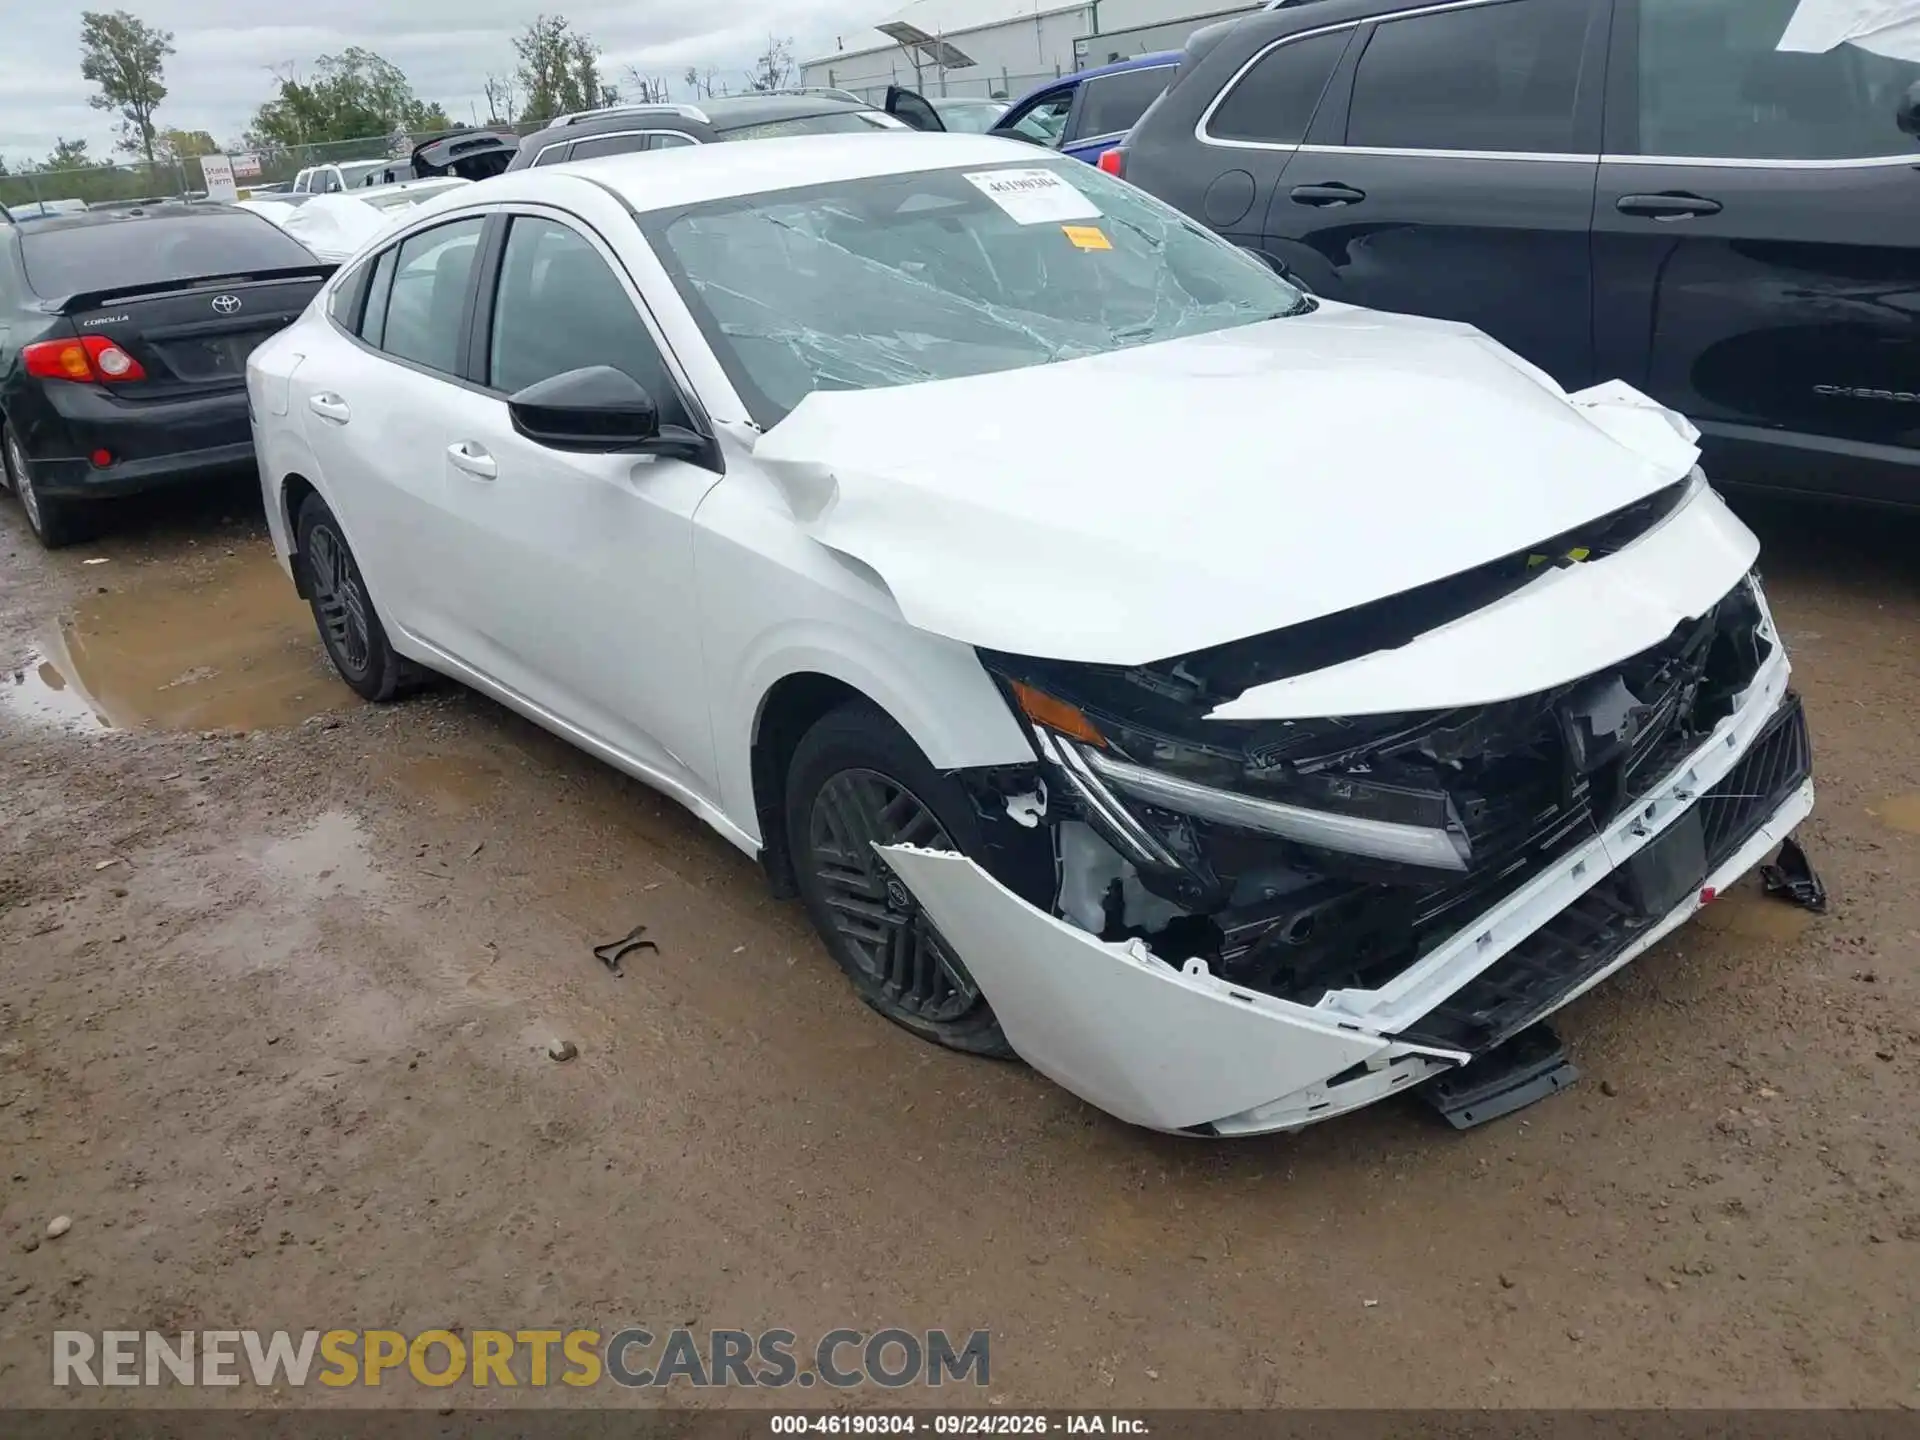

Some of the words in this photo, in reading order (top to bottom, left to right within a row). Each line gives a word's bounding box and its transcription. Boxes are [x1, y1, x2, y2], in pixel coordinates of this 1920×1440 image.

[204, 167, 229, 175] State
[989, 178, 1061, 192] 46190304
[83, 314, 129, 327] COROLLA
[1813, 384, 1920, 402] CHERO
